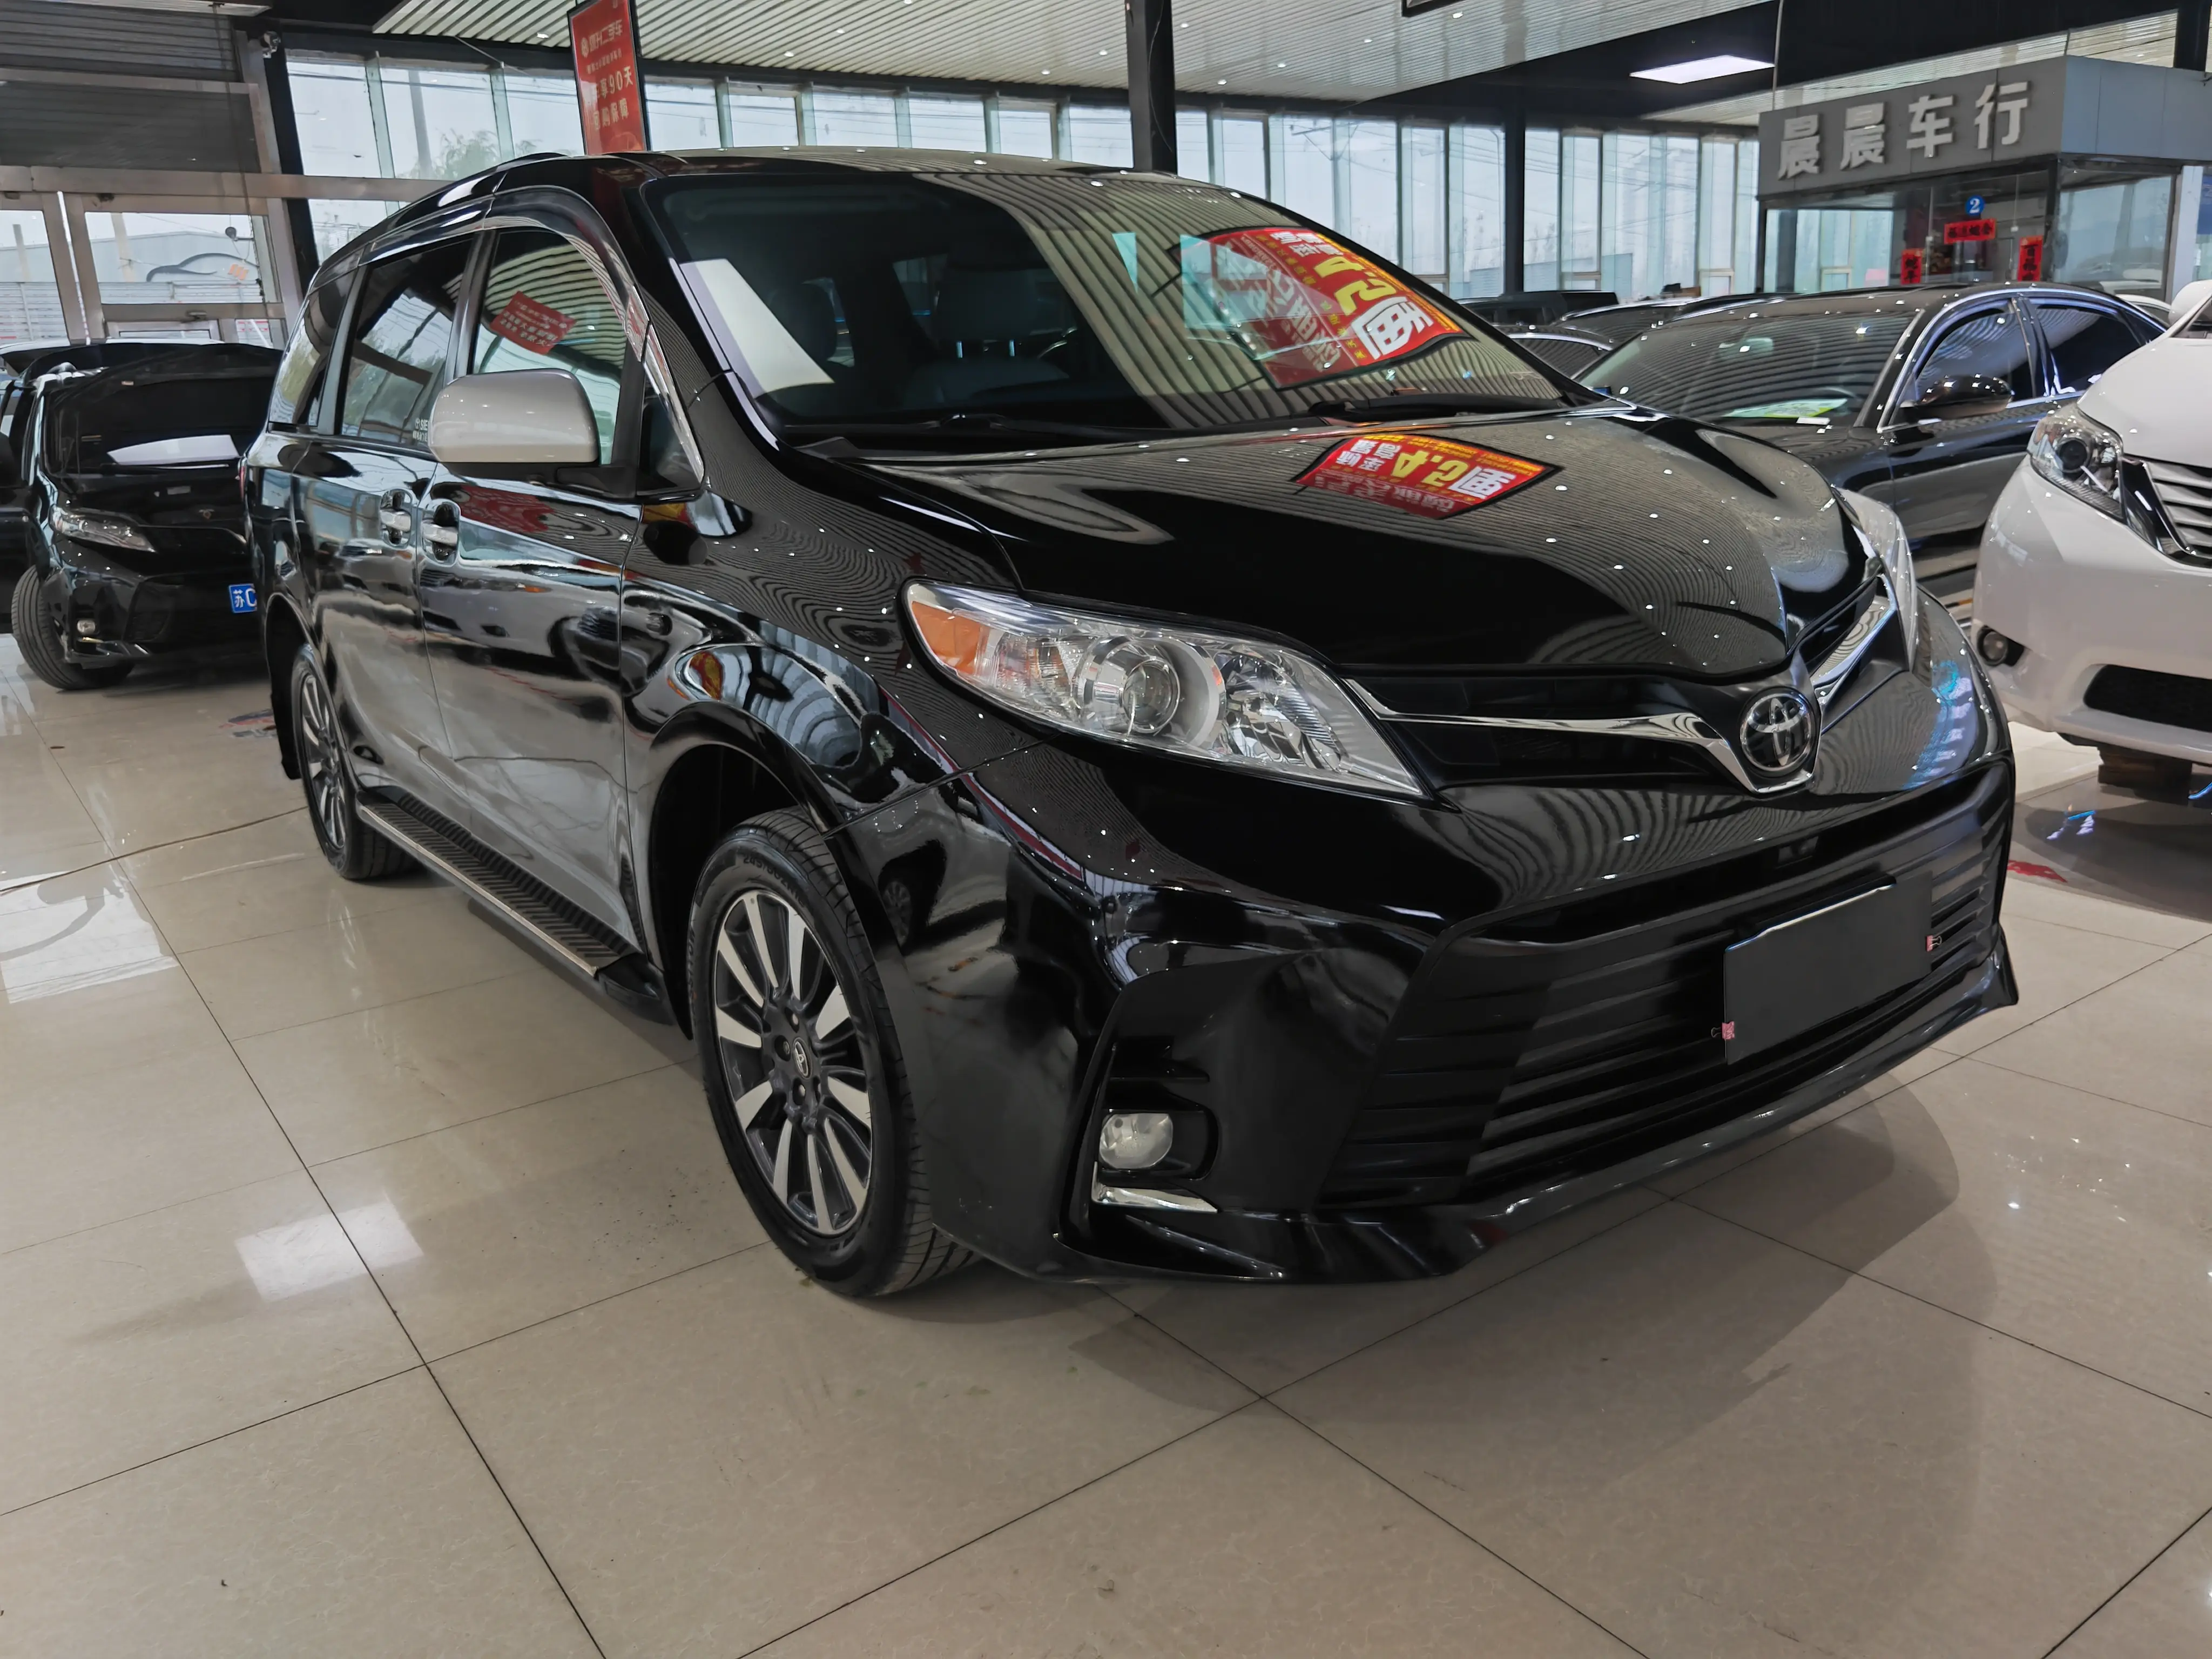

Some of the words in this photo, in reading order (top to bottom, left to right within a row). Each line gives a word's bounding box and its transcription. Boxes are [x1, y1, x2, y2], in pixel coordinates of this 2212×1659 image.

[593, 65, 633, 99] 享90天
[1778, 81, 2029, 181] 晨晨车行
[1969, 198, 1980, 214] 2
